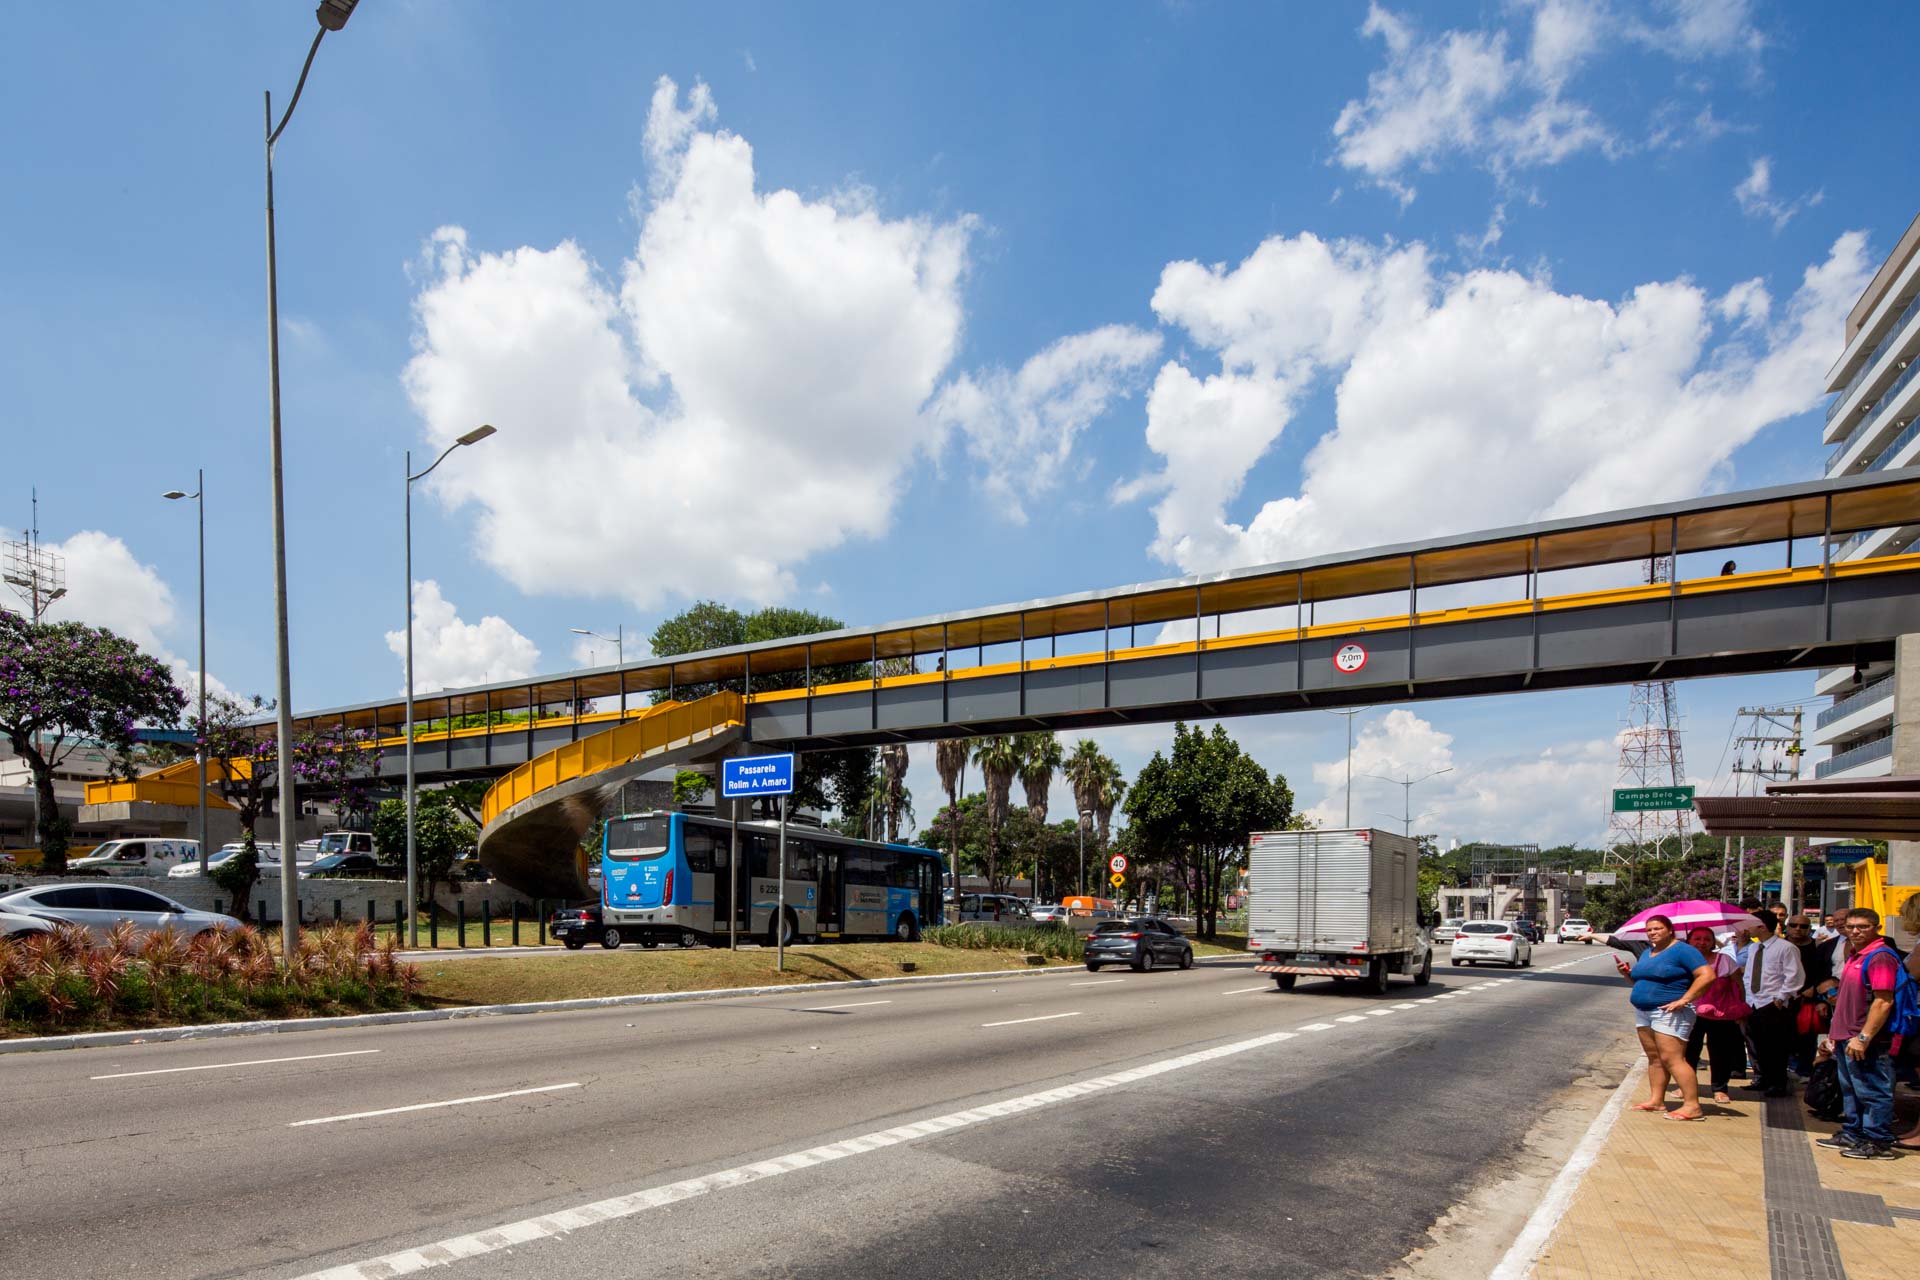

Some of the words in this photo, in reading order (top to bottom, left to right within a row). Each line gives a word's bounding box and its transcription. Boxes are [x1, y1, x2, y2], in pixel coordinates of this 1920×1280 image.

[1341, 654, 1362, 662] 7,0m
[739, 764, 776, 775] Passarela
[728, 780, 749, 790] Rolim
[761, 777, 787, 787] Amaro
[1113, 859, 1124, 868] 40
